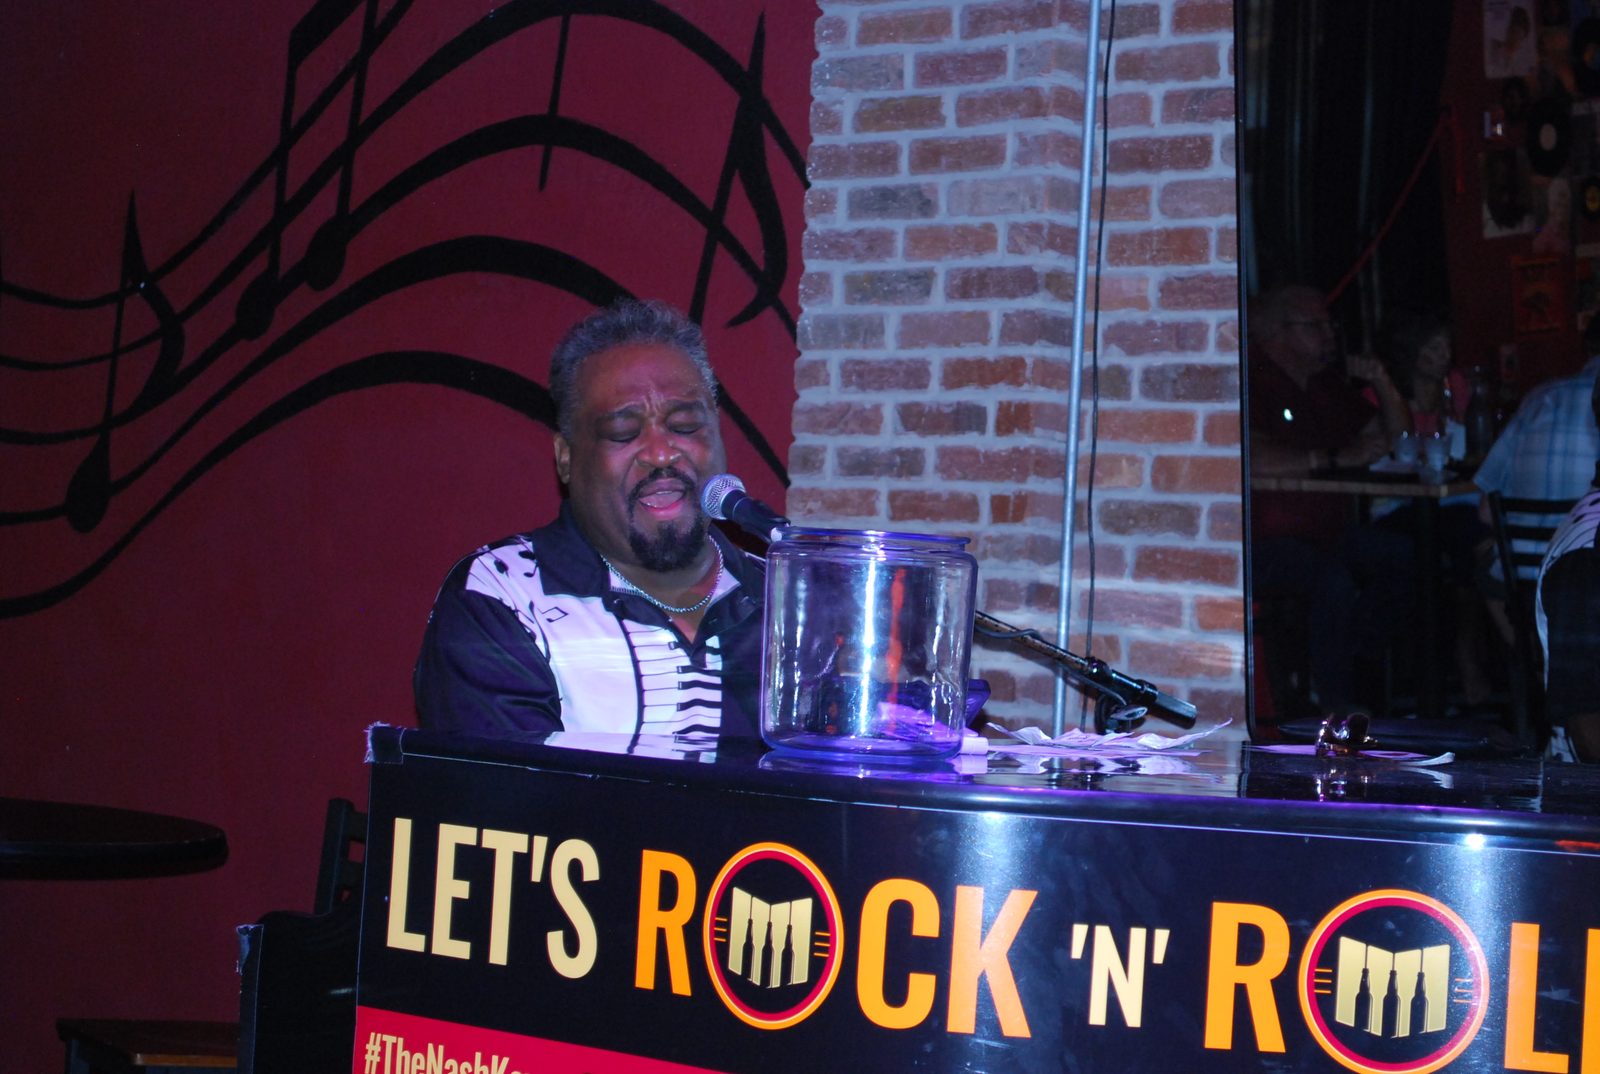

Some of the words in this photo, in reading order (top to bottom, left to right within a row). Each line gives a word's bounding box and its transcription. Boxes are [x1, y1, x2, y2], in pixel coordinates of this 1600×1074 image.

[386, 817, 600, 979] LET'S
[635, 842, 1038, 1039] ROCK
[1070, 923, 1170, 1028] 'N'
[364, 1032, 530, 1074] #TheNashK
